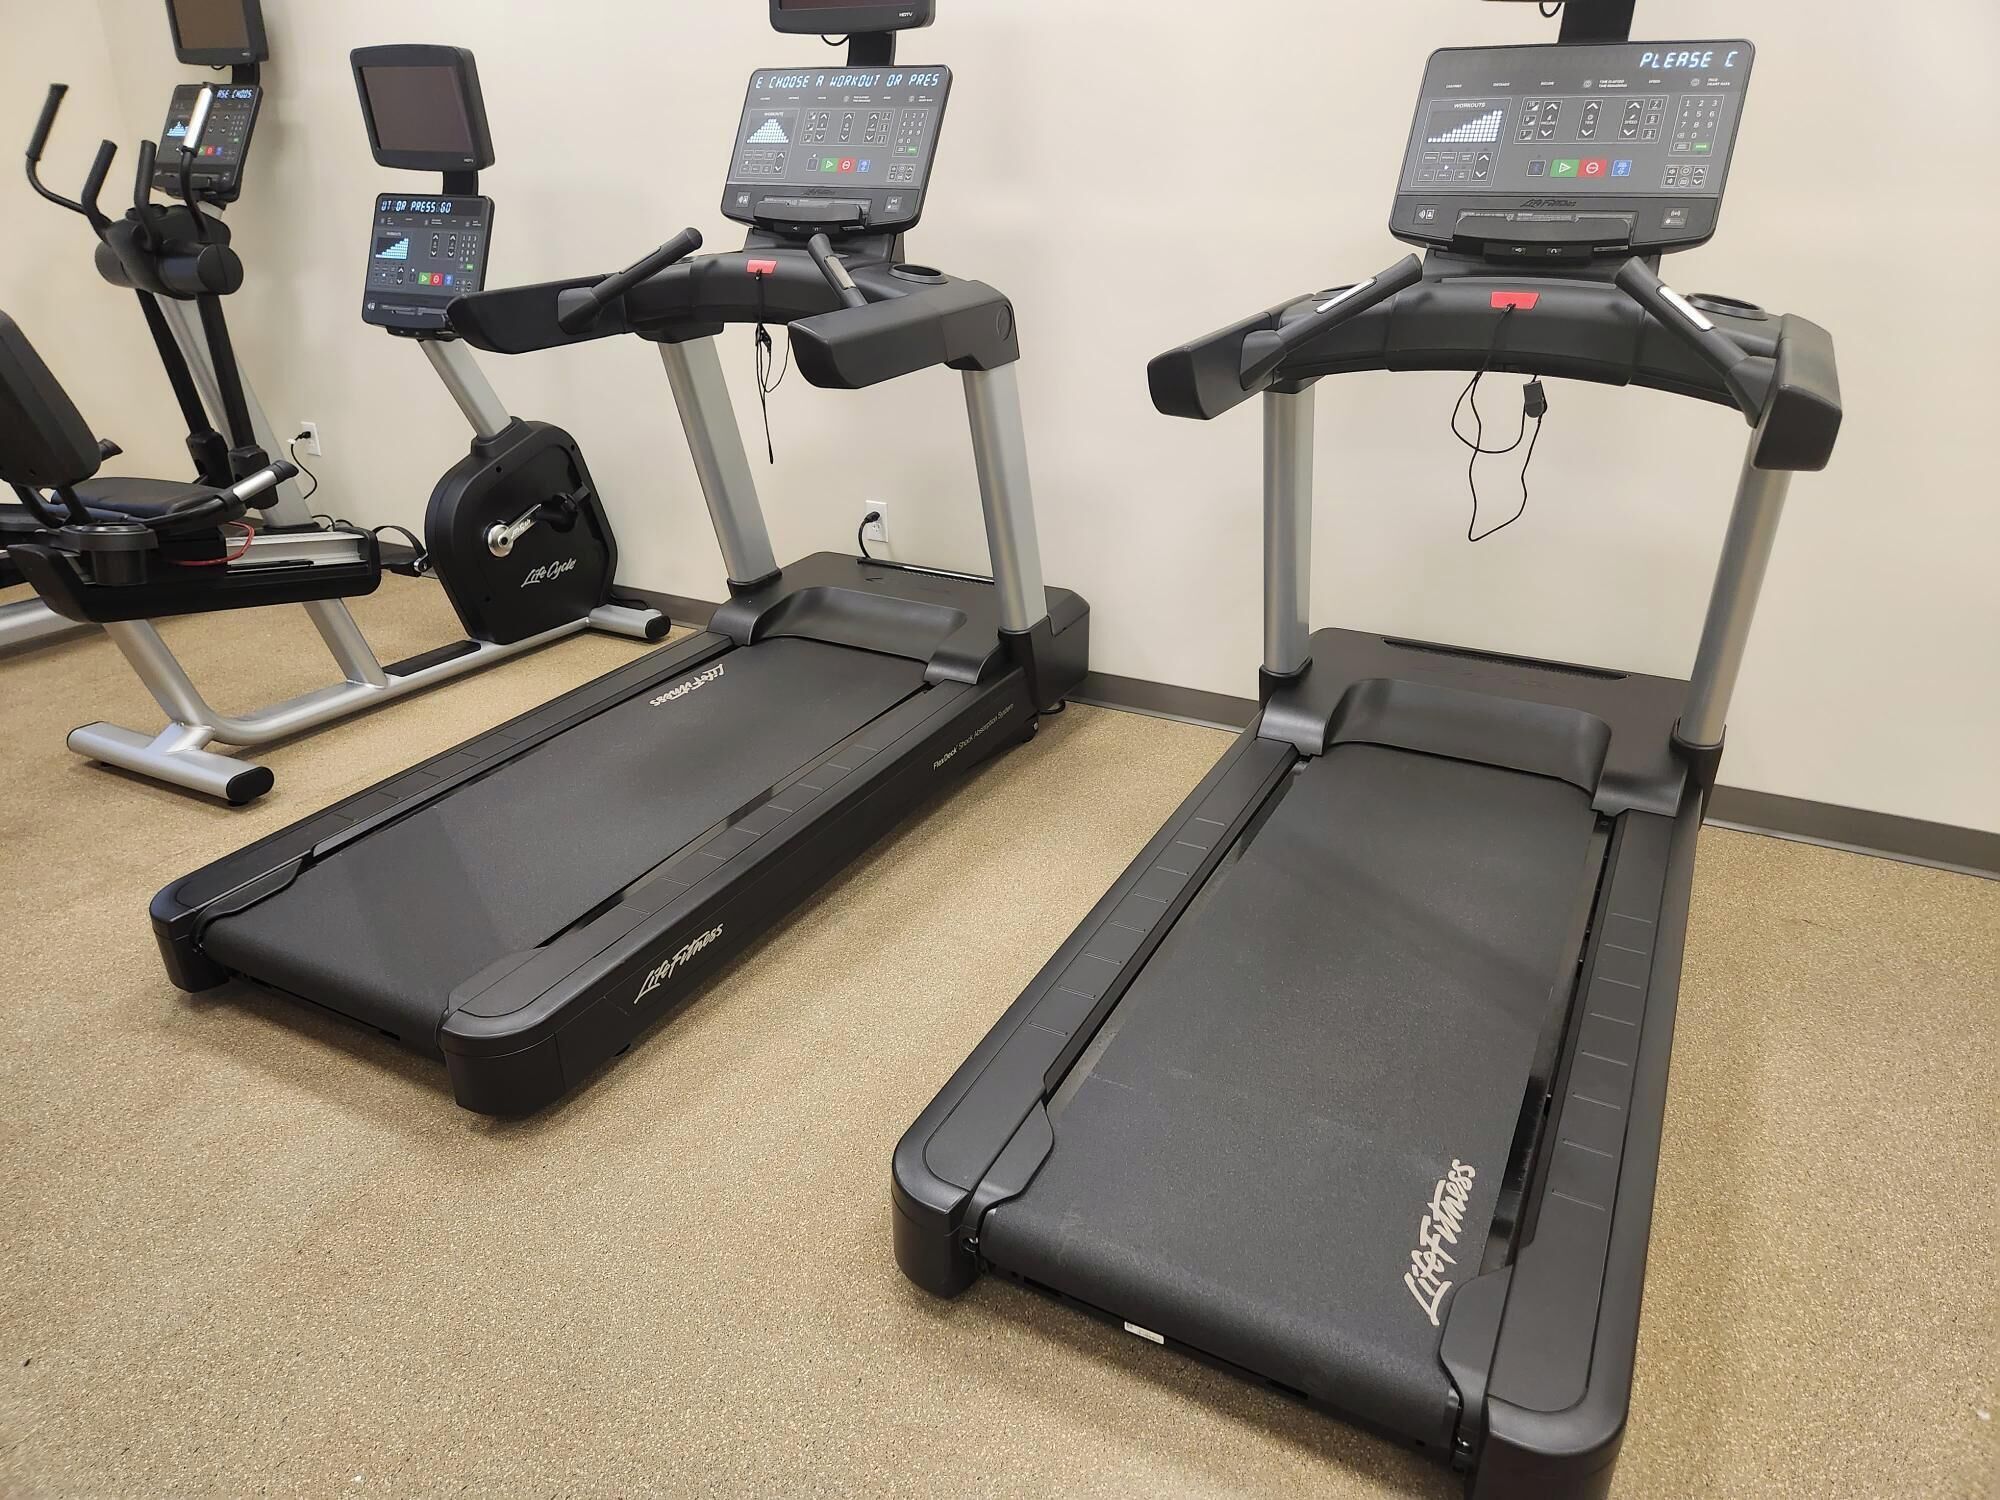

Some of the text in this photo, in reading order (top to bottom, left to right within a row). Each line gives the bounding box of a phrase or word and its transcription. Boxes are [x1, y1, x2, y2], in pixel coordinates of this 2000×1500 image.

[1639, 51, 1739, 68] PLEASE C
[755, 73, 940, 89] E CHOOSE A WORKOUT OR PRES
[410, 201, 436, 213] PRESS
[440, 201, 452, 213] GO
